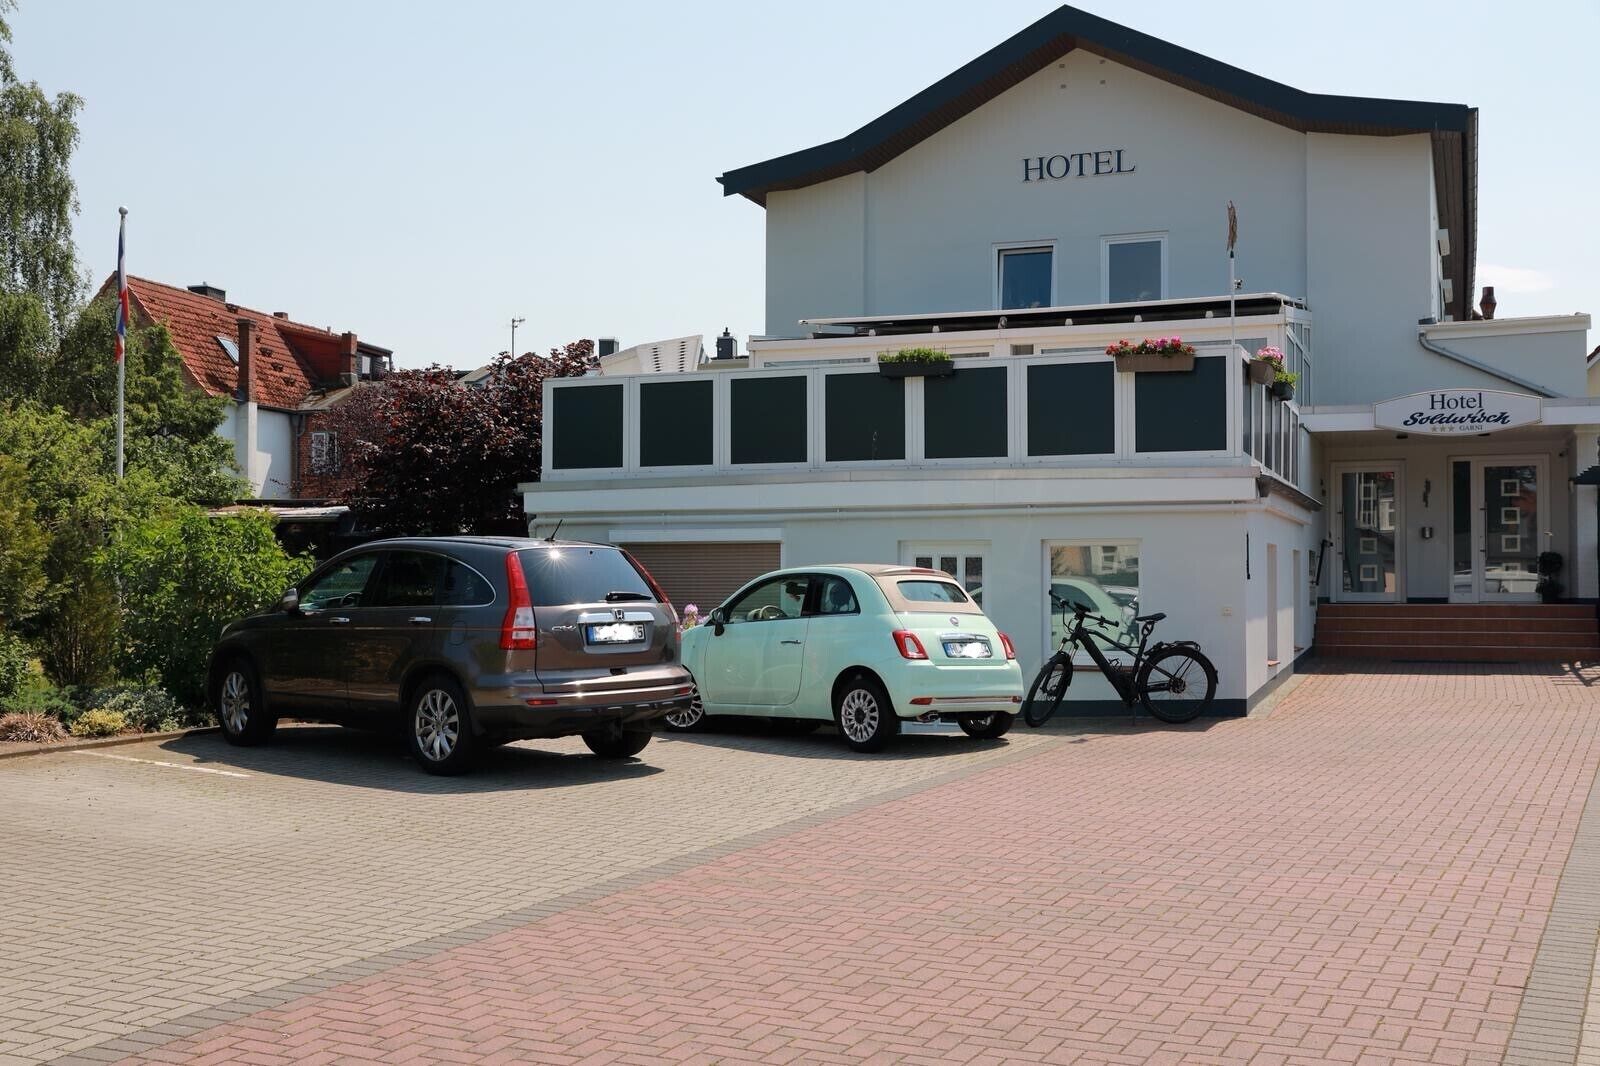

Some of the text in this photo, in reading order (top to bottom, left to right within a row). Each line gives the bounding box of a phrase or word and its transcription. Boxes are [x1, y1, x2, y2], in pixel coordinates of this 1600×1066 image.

[1022, 149, 1136, 182] HOTEL
[1429, 392, 1484, 410] Hotel
[1403, 408, 1511, 427] Soldwisch
